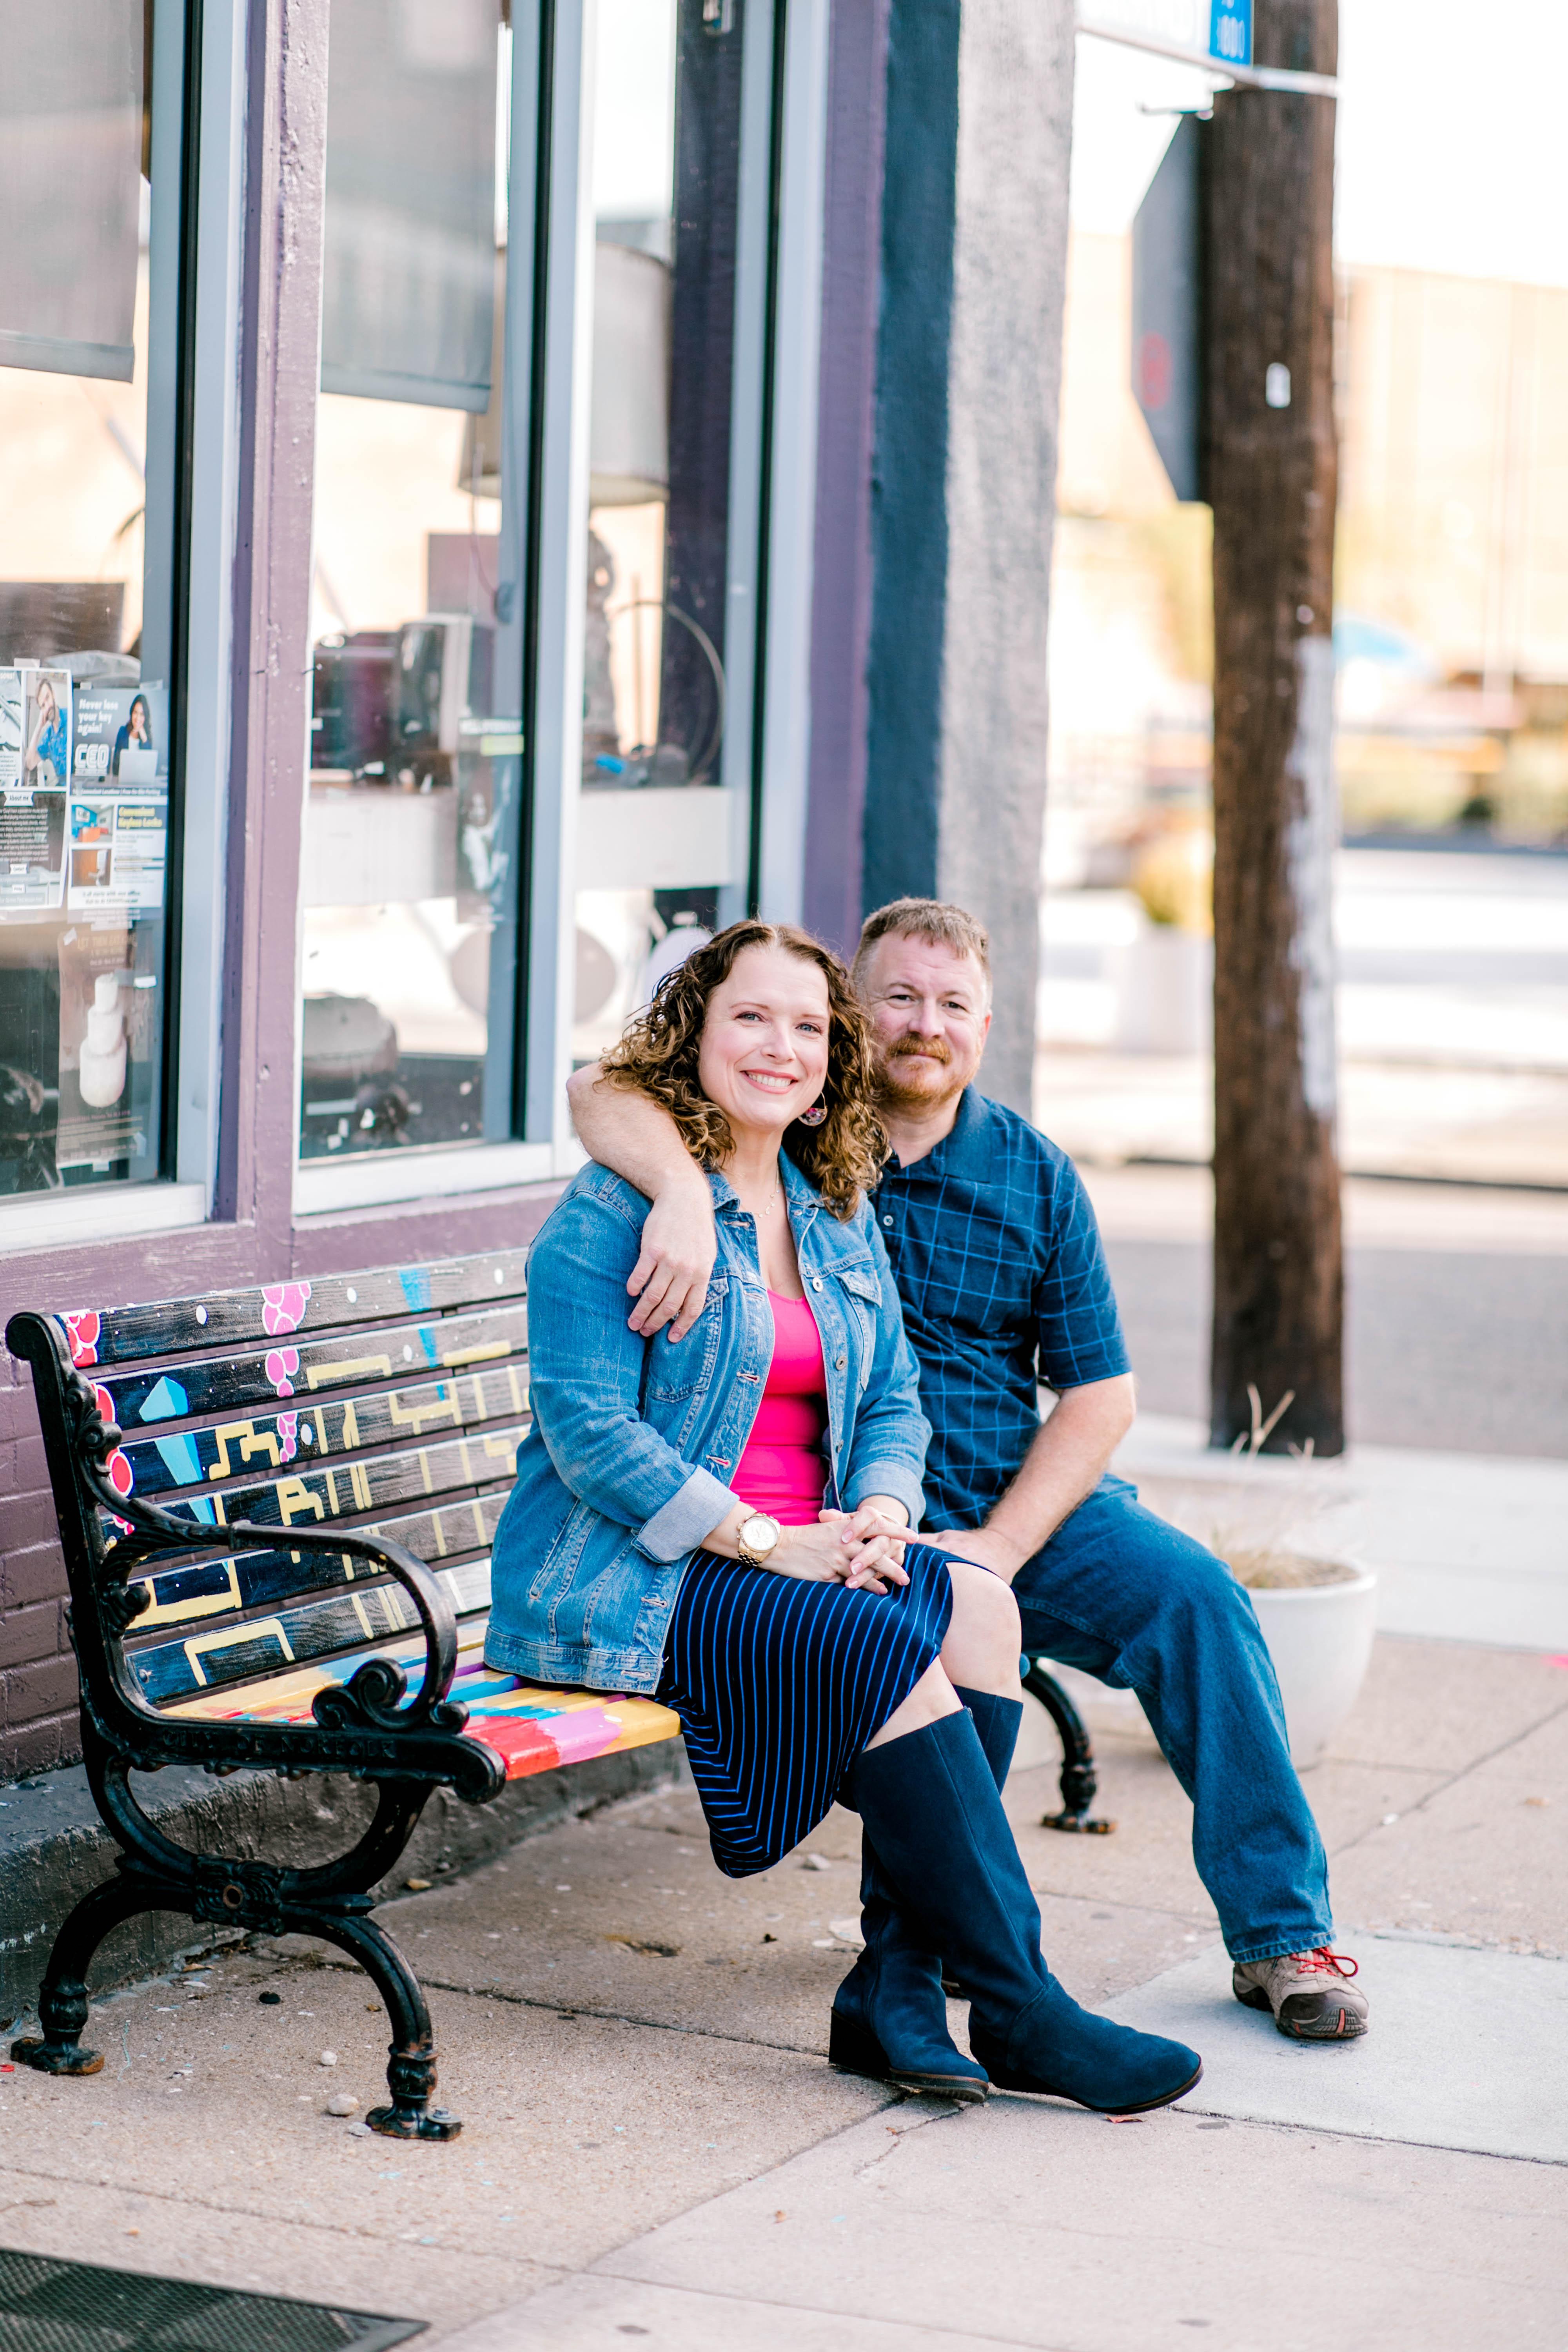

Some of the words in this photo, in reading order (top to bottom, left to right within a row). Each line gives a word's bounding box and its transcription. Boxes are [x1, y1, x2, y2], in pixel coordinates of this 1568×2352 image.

[79, 699, 102, 710] Never
[103, 699, 118, 710] lose
[78, 713, 97, 724] your
[98, 711, 112, 724] key
[77, 722, 102, 737] again!
[74, 743, 110, 769] CEO
[163, 1729, 218, 1749] CITY
[237, 1734, 265, 1755] OF
[281, 1735, 396, 1759] NORFOLK
